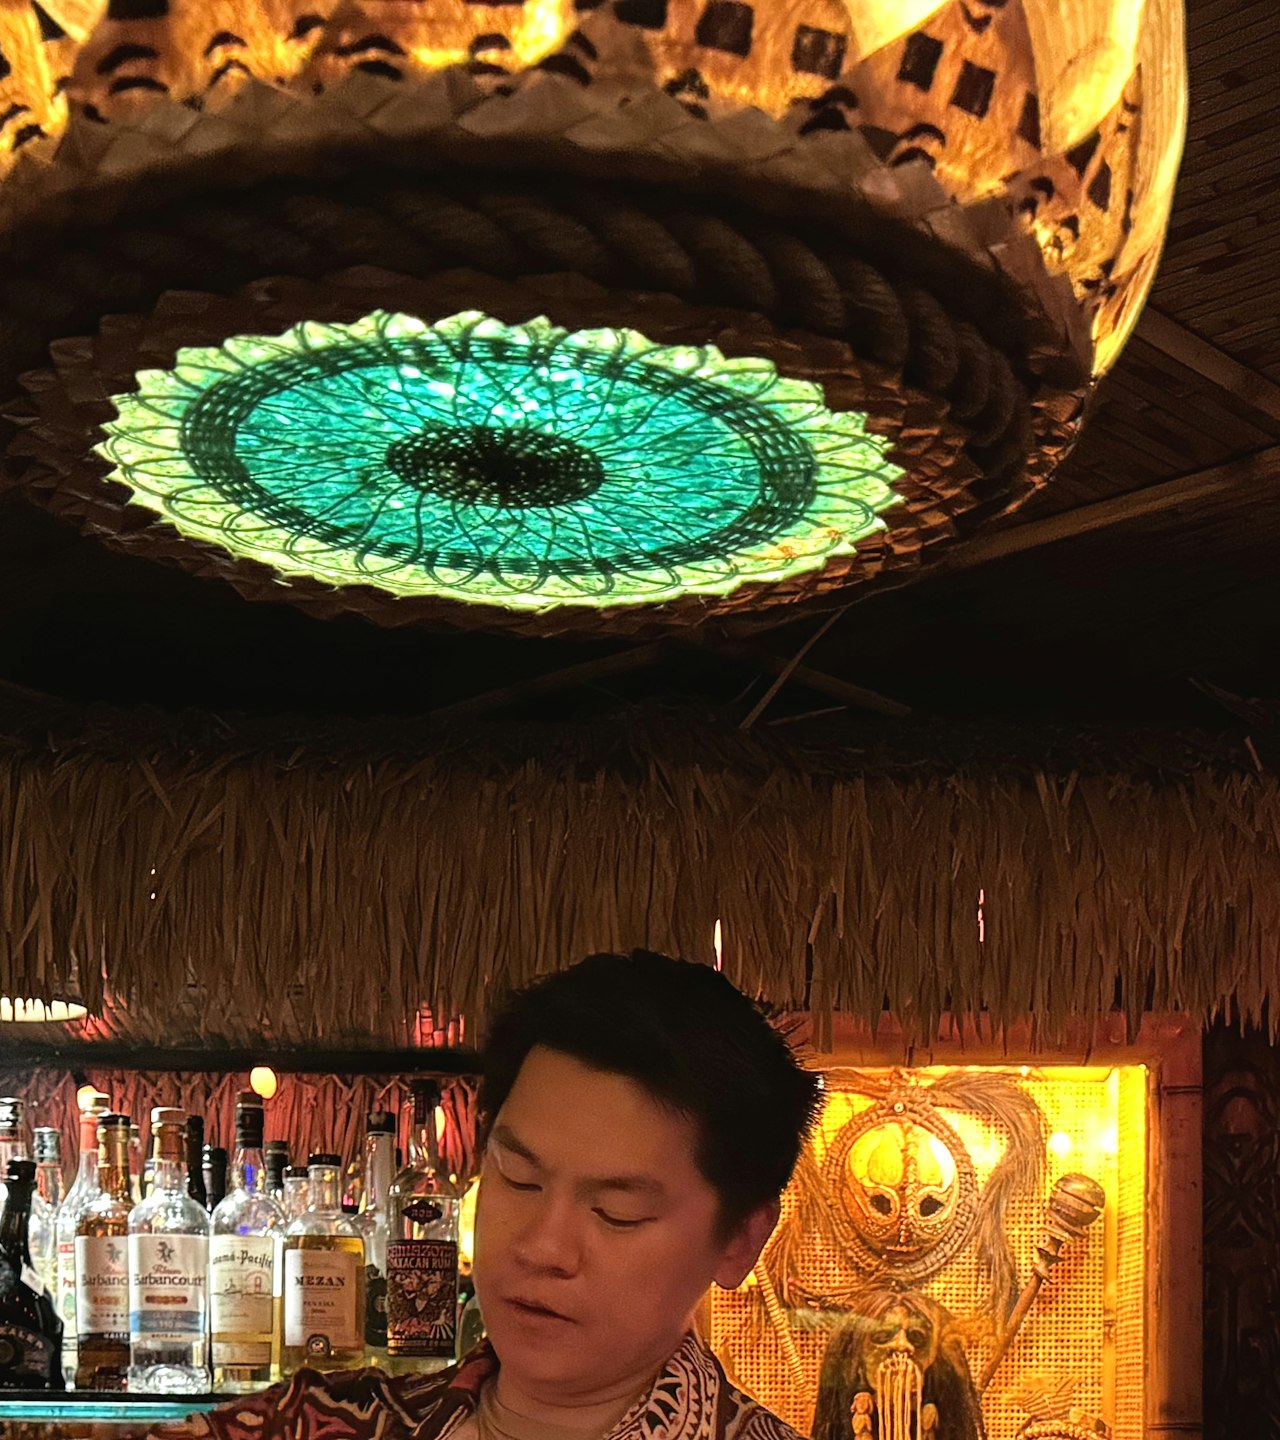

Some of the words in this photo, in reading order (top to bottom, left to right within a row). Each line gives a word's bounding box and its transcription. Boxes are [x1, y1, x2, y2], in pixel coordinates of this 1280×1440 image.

[81, 1273, 129, 1287] Barbanc
[133, 1271, 206, 1288] Barbancourt
[294, 1275, 346, 1287] MEZAN
